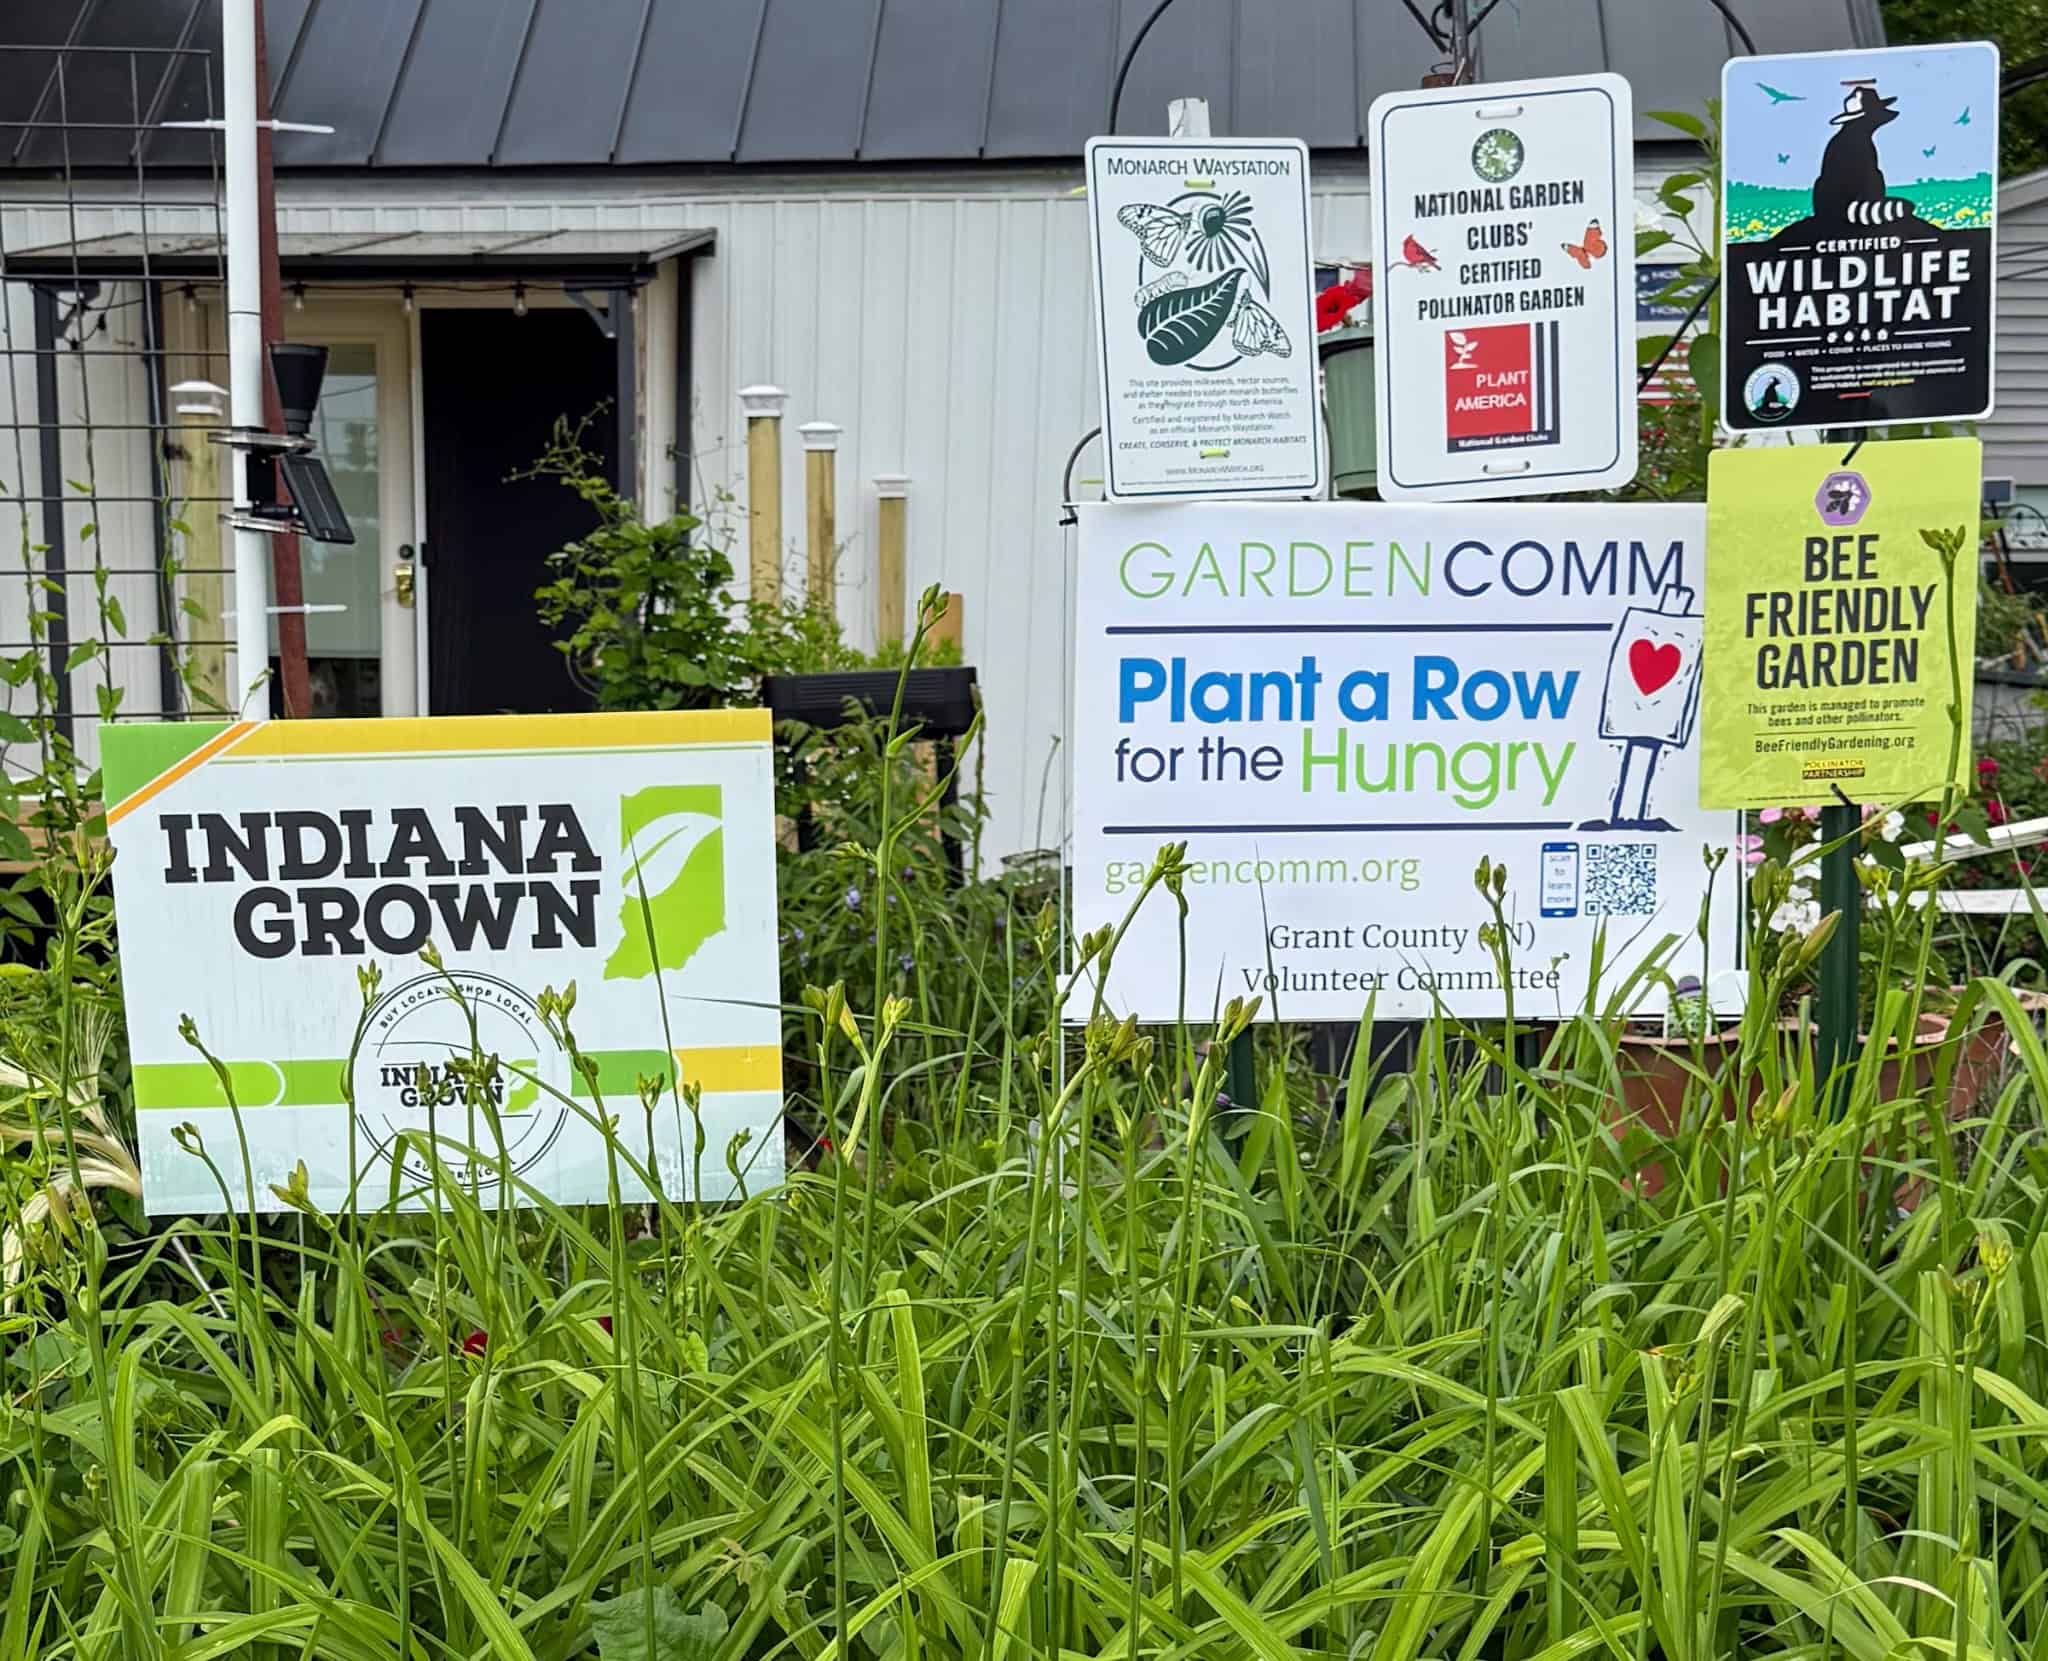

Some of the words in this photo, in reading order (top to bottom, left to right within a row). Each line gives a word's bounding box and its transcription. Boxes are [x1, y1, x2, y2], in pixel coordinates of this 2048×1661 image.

[1107, 158, 1188, 176] MONARCH
[1193, 157, 1290, 176] WAYSTATION
[1415, 187, 1504, 218] NATIONAL
[1510, 180, 1584, 209] GARDEN
[1467, 222, 1533, 250] CLUBS'
[1815, 236, 1901, 254] CERTIFIED
[1460, 258, 1541, 285] CERTIFIED
[1746, 249, 1971, 294] WILDLIFE
[1418, 291, 1514, 320] POLLINATOR
[1520, 286, 1585, 311] GARDEN
[1758, 286, 1960, 331] HABITAT
[1476, 370, 1528, 388] PLANT
[1455, 393, 1527, 412] AMERICA
[1200, 439, 1231, 447] PROTECT
[1119, 540, 1684, 599] GARDENCOMM
[1804, 534, 1880, 582] BEE
[1745, 584, 1938, 638] FRIENDLY
[1756, 638, 1918, 690] GARDEN
[1119, 656, 1322, 724] Plant
[1338, 670, 1390, 723] a
[1412, 655, 1581, 722] Row
[1747, 703, 1767, 714] This
[1771, 702, 1806, 716] garden
[1809, 700, 1818, 712] is
[1820, 699, 1867, 712] managed
[1870, 699, 1880, 709] to
[1883, 697, 1925, 710] promote
[1768, 717, 1792, 727] bees
[1795, 715, 1814, 726] and
[1816, 713, 1843, 725] other
[1846, 711, 1904, 726] pollinators.
[1755, 735, 1915, 753] BeeFriendlyGardening.org
[1115, 737, 1184, 783] for
[1198, 736, 1284, 782] the
[1302, 727, 1577, 810] Hungry
[1803, 768, 1865, 779] PARTNERSHIP
[158, 803, 602, 884] INDIANA
[1104, 857, 1421, 895] gaencomm.org
[233, 879, 600, 959] GROWN
[1270, 925, 1354, 950] Grant
[1363, 924, 1468, 954] County
[1478, 920, 1535, 952] N)
[1242, 966, 1389, 992] Volunteer
[1397, 967, 1560, 991] Commtee
[380, 1007, 399, 1028] BUY
[401, 986, 443, 1008] LOCAL
[497, 994, 532, 1024] LOCAL
[380, 1065, 504, 1087] INIA
